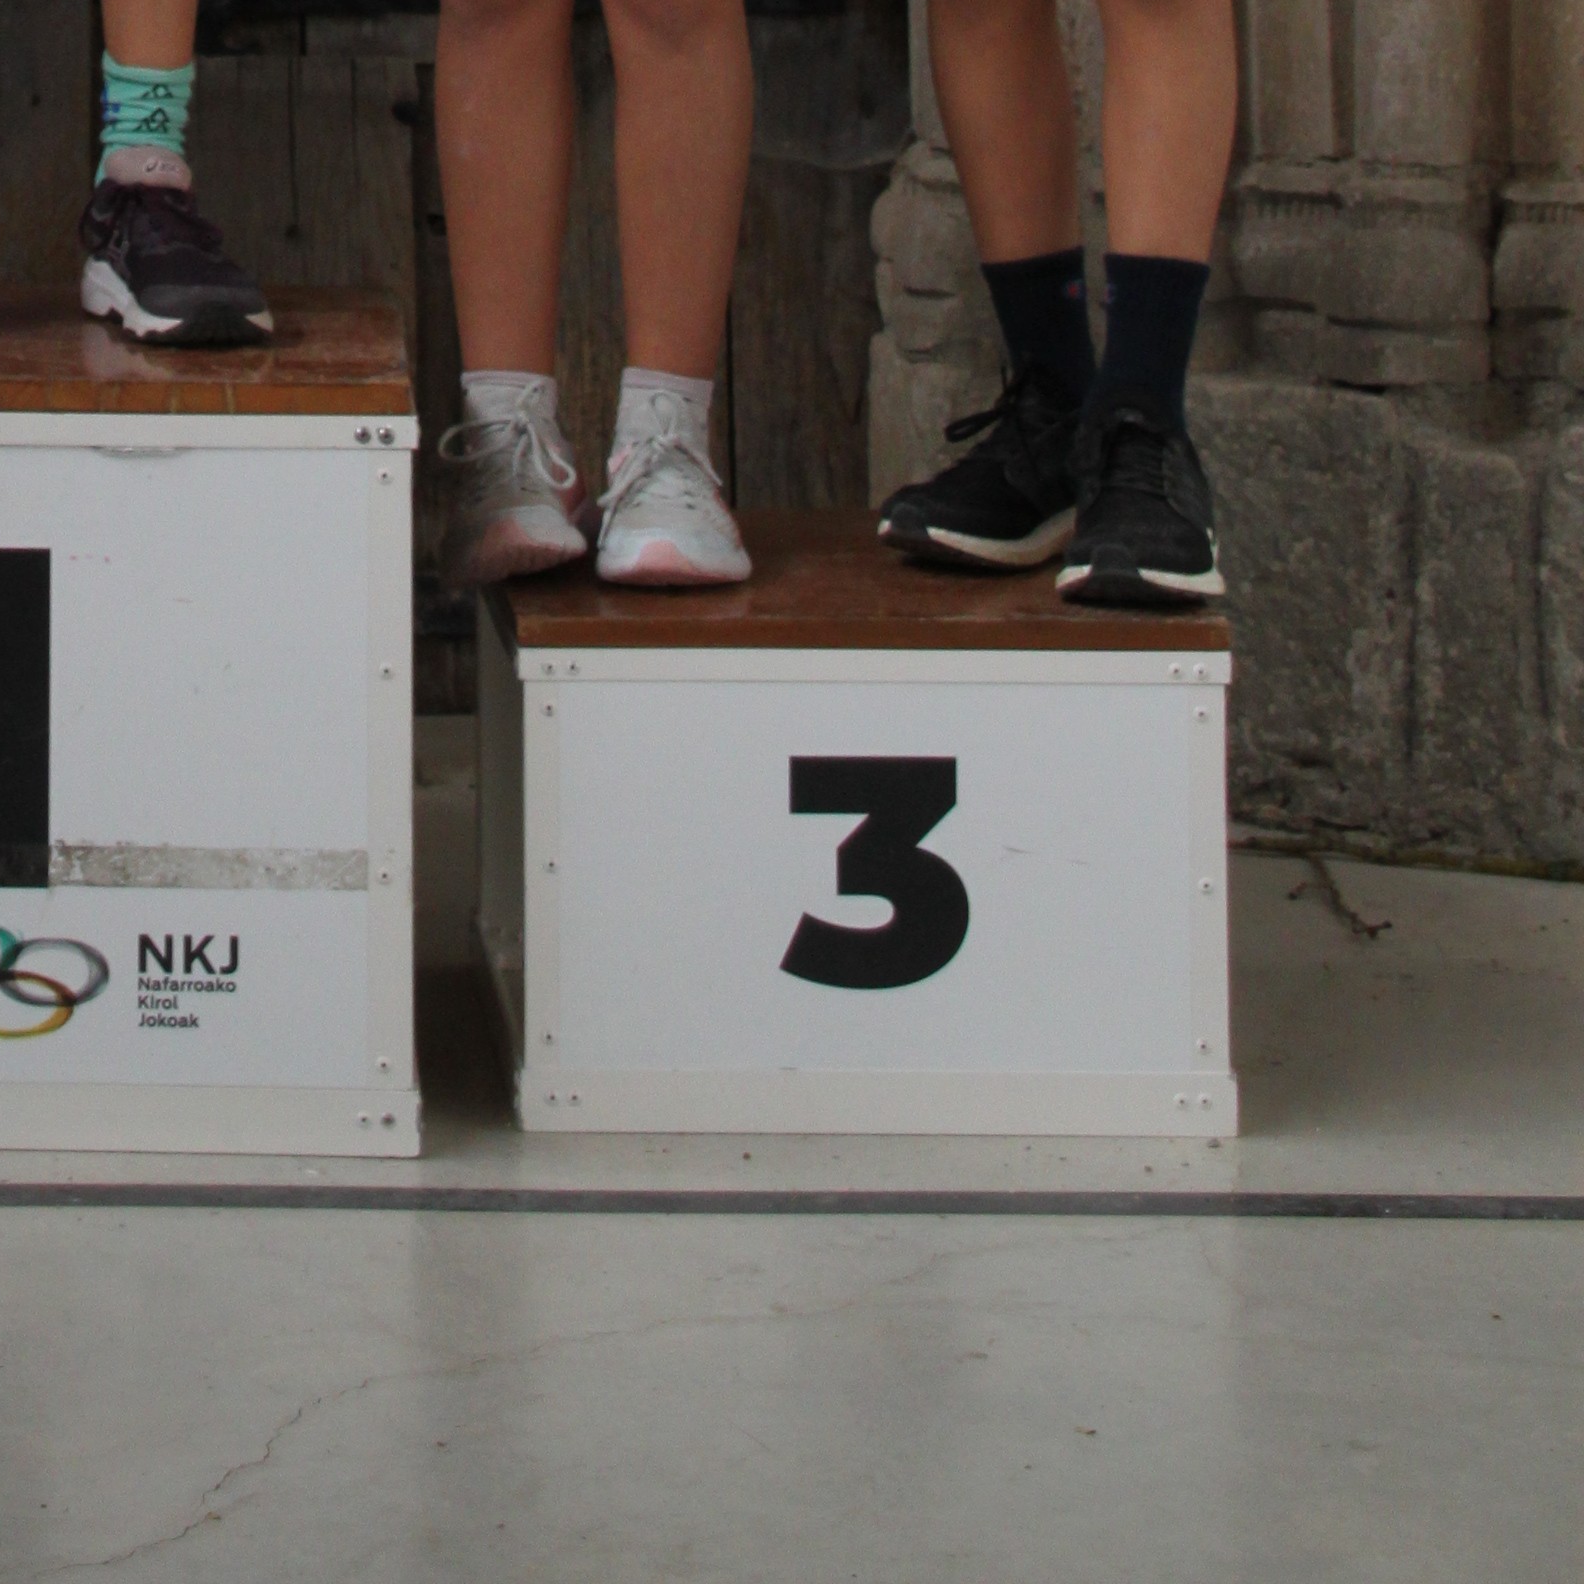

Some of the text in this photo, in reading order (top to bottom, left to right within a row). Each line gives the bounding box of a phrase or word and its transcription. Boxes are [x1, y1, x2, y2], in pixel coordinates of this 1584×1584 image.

[778, 755, 970, 990] 3
[138, 934, 239, 975] NKJ
[138, 977, 236, 992] Nafarroako
[138, 995, 178, 1009] Kirol
[138, 1013, 199, 1028] Jokoak
